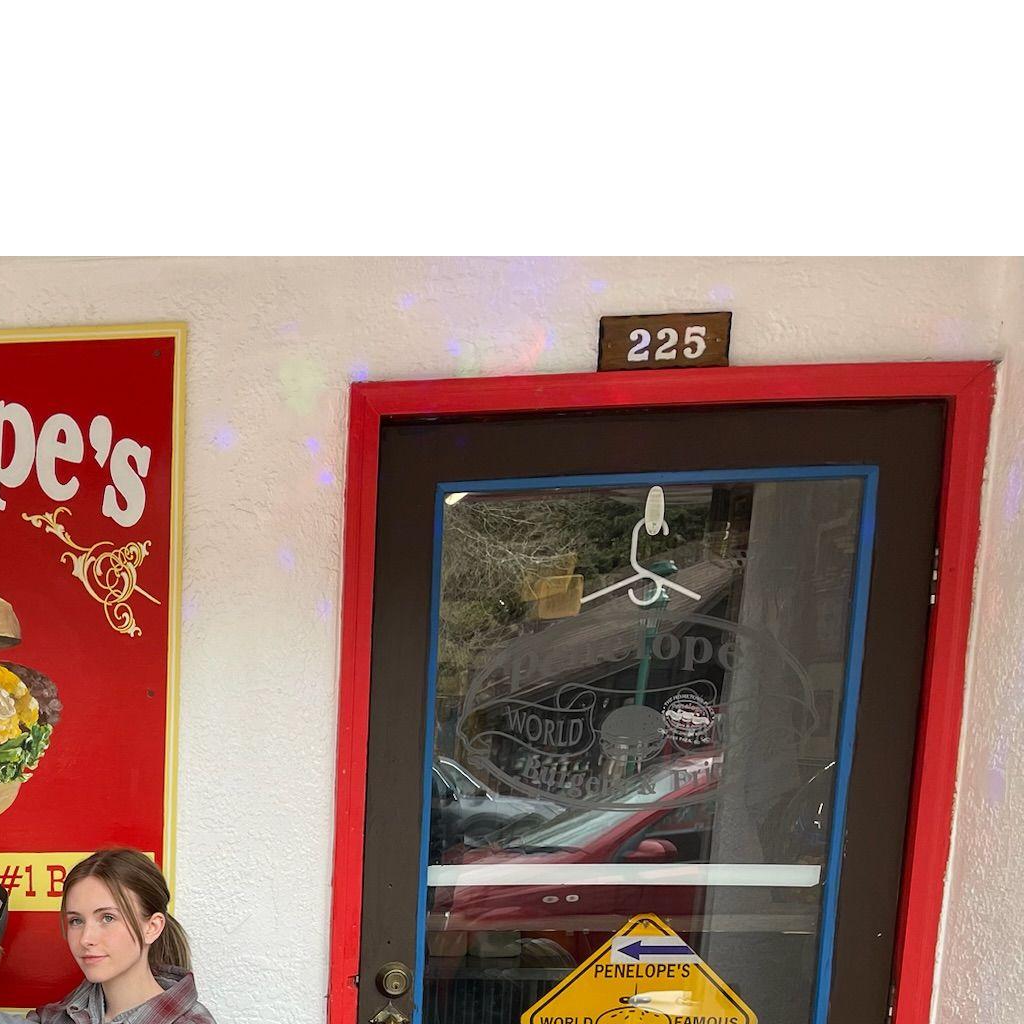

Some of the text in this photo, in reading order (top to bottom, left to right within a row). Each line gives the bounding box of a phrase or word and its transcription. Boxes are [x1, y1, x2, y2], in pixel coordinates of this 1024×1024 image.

[627, 326, 707, 362] 225
[505, 705, 585, 748] WORLD
[593, 963, 691, 979] PENELOPE'S
